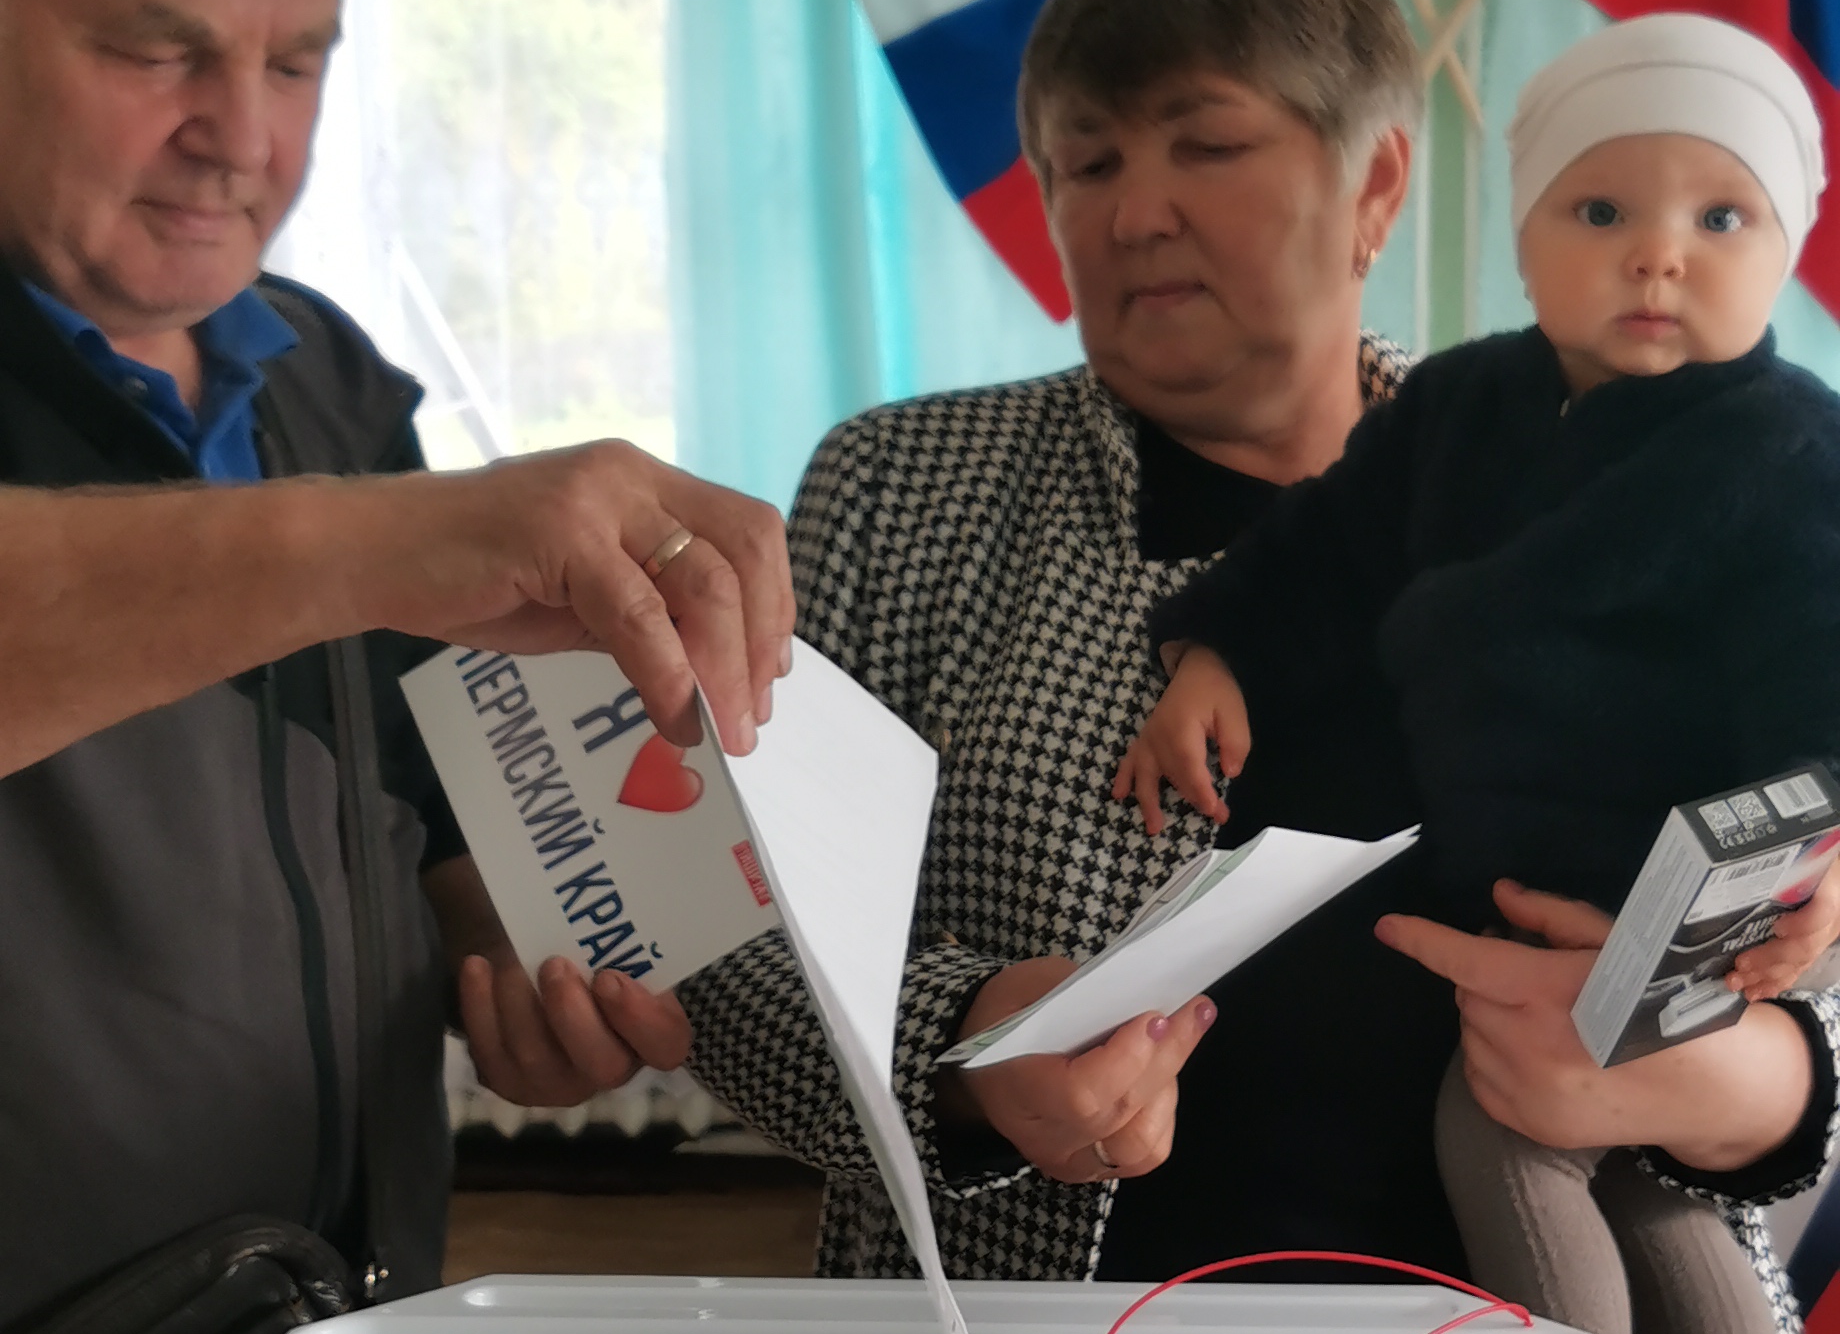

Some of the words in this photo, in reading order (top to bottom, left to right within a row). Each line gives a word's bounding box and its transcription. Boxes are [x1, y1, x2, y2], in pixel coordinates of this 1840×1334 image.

[455, 647, 606, 872] ПЕРМСКИЙ
[554, 860, 665, 979] КРАЙ
[572, 688, 649, 754] Я
